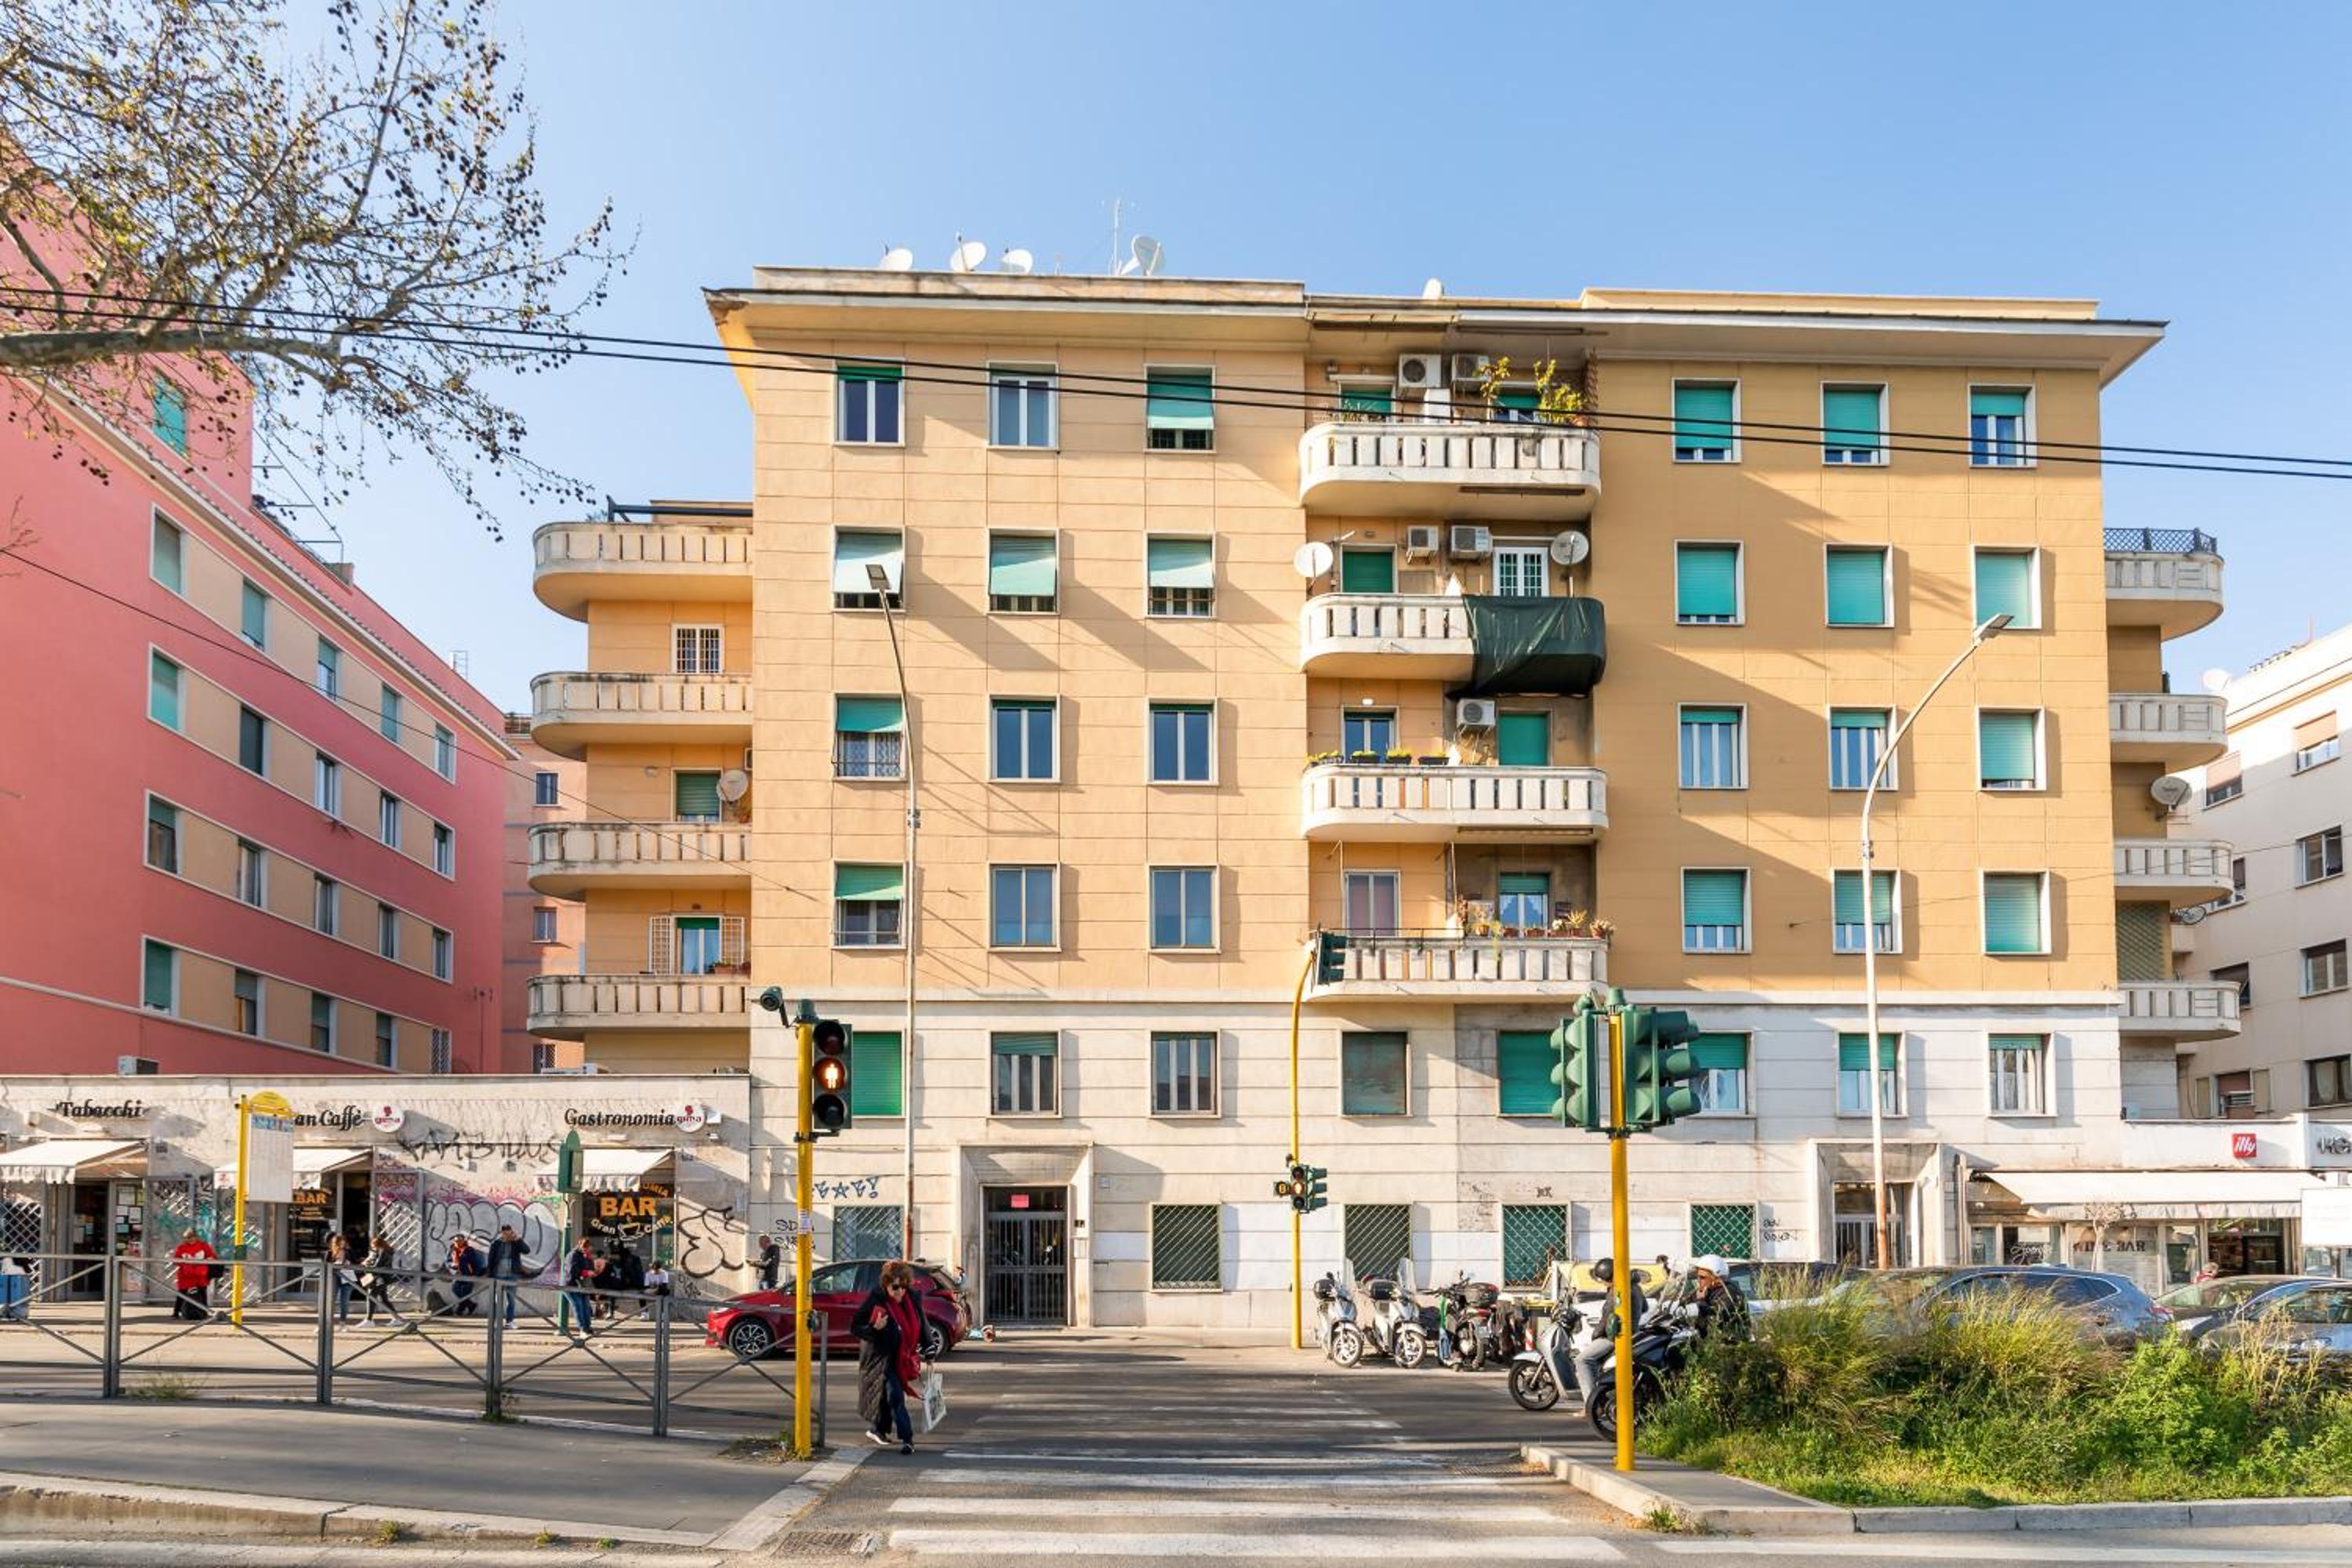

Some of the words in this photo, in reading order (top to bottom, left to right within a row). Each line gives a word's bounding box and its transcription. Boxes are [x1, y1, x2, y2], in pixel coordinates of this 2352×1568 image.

[56, 1098, 143, 1118] Tabacchi
[295, 1113, 319, 1127] an
[564, 1108, 676, 1127] Gastronomia
[2235, 1137, 2256, 1155] illy
[601, 1196, 657, 1216] BAR
[590, 1218, 616, 1235] Gran
